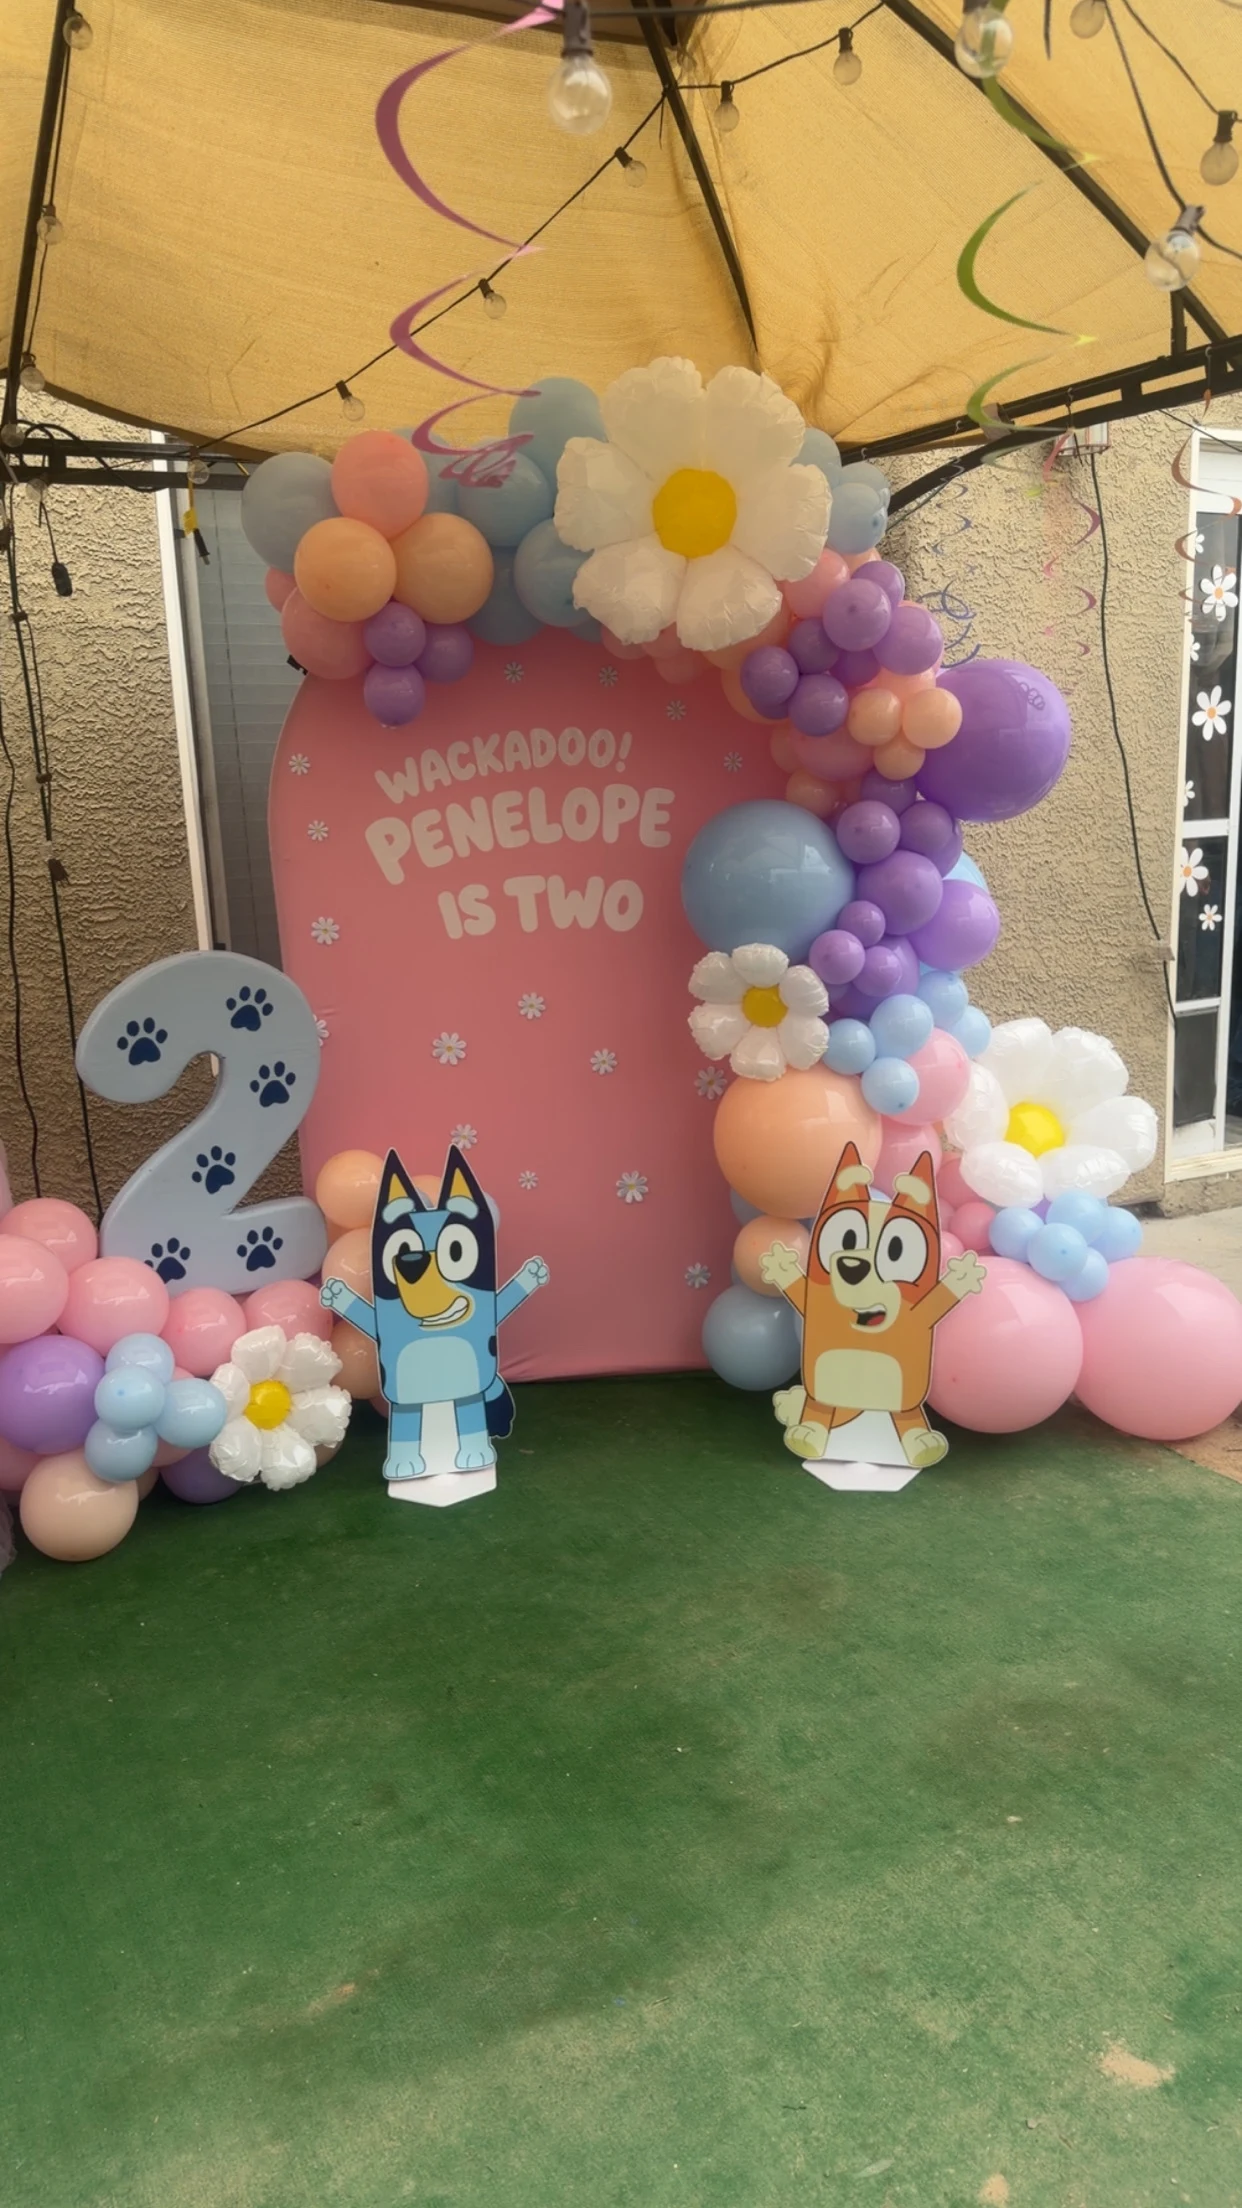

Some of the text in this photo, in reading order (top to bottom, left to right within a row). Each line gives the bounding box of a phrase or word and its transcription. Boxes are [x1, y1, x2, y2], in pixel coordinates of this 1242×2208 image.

[374, 726, 633, 804] WACKADOO!
[365, 783, 676, 885] PENELOPE
[437, 874, 644, 940] IS TWO
[75, 950, 328, 1297] 2
